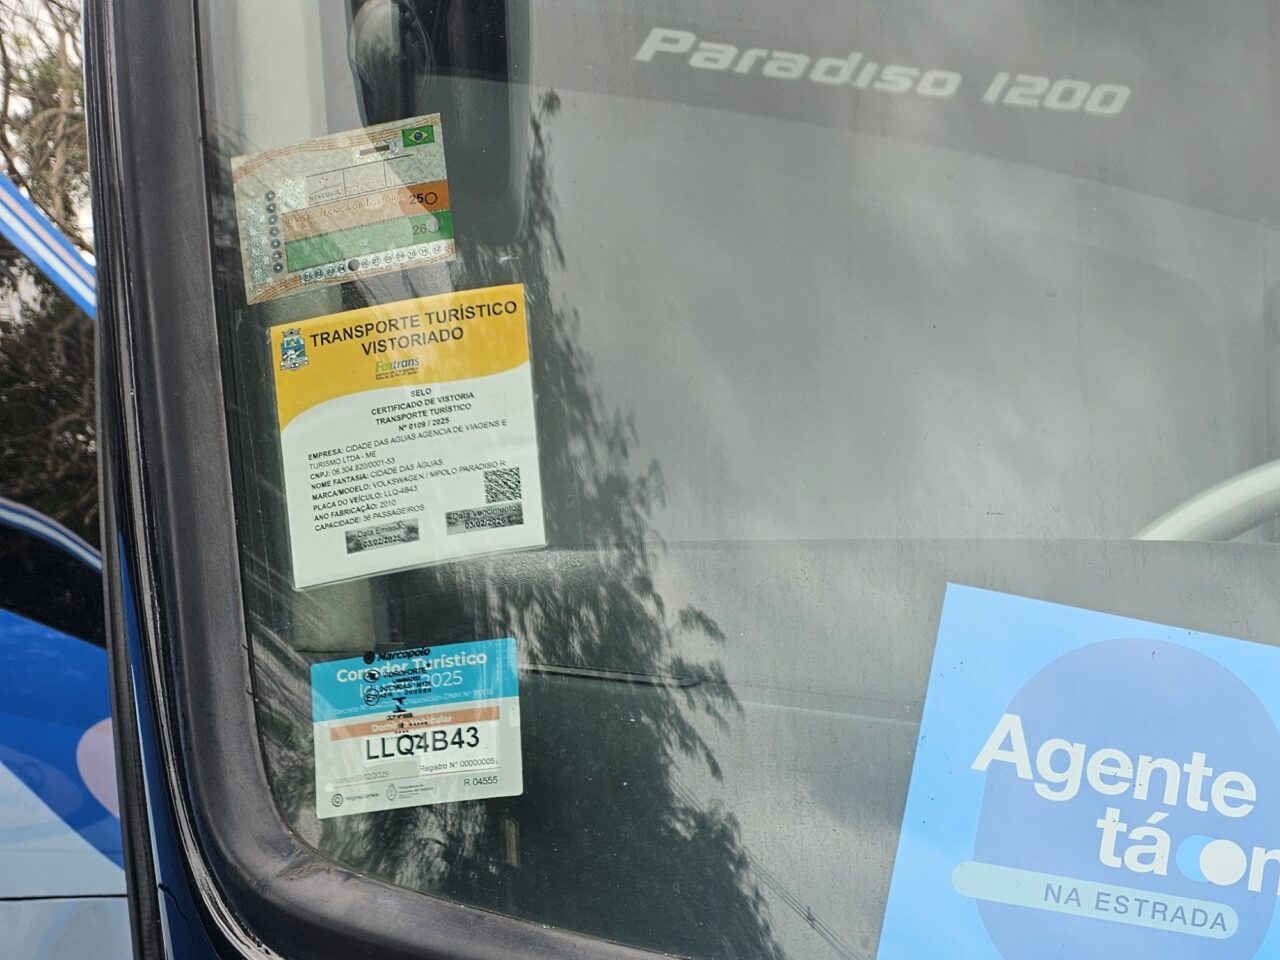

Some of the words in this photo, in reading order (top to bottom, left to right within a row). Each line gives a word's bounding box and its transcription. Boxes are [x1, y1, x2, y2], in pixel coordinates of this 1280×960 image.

[634, 26, 962, 99] Paradiso
[981, 71, 1132, 116] 1200
[412, 225, 427, 235] 26
[310, 314, 421, 348] TRANSPORTE
[424, 300, 518, 324] TURÍSTICO
[361, 326, 464, 356] VISTORIADO
[371, 400, 423, 415] CERTIFICADO
[425, 398, 435, 406] DE
[437, 392, 475, 403] VISTORIA
[411, 388, 432, 397] SELO
[376, 410, 428, 425] TRANSPORTE
[430, 403, 472, 415] TURÍSTICO
[432, 417, 450, 427] 2025
[308, 448, 344, 460] EMPRESA:
[345, 441, 372, 453] CIDADE
[373, 438, 389, 447] DAS
[452, 425, 463, 433] DE
[465, 420, 500, 431] VIAGENS
[309, 458, 341, 470] TURISMO
[342, 454, 360, 464] LTDA
[310, 471, 330, 480] CNPJ:
[311, 480, 331, 490] NOME
[333, 473, 369, 486] FANTASIA:
[370, 467, 397, 478] CIDADE
[399, 464, 415, 473] DAS
[372, 473, 425, 489] VOLKSWAGEN
[459, 461, 499, 472] PARADISO
[313, 501, 336, 512] PLACA
[337, 498, 348, 507] DO
[349, 491, 383, 504] VEÍCULO:
[314, 513, 329, 521] ANO
[331, 503, 379, 518] FABRICAÇÃO:
[380, 499, 397, 509] 2010
[315, 517, 362, 531] CAPACIDADE:
[373, 504, 425, 520] PASSAGEIROS
[337, 661, 409, 683] Cordor
[412, 651, 488, 670] Turístico
[421, 670, 463, 687] 2025
[366, 726, 480, 760] LLQ4B43
[419, 763, 447, 773] Registro
[970, 713, 1257, 818] Agente
[464, 778, 470, 786] R
[472, 775, 498, 786] 04555
[1095, 807, 1172, 876] tá
[1043, 882, 1083, 908] NA
[1094, 891, 1229, 933] ESTRADA
